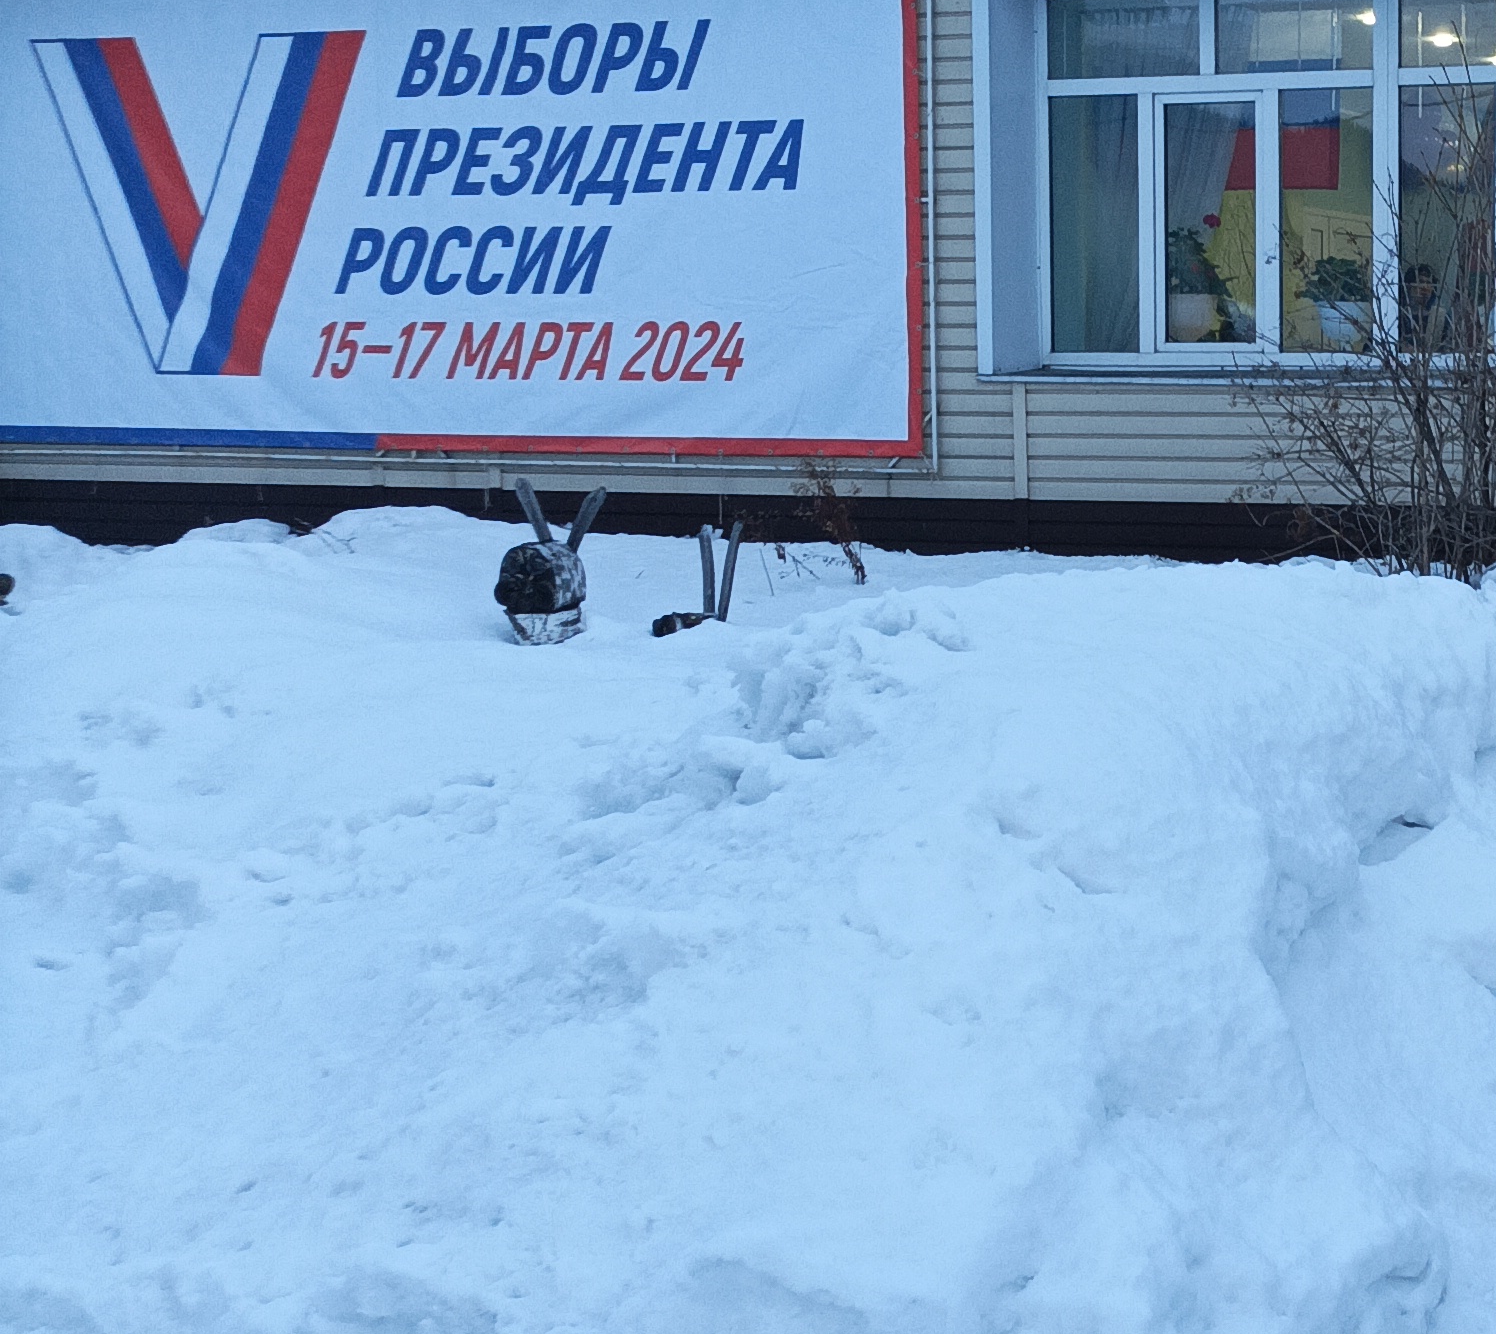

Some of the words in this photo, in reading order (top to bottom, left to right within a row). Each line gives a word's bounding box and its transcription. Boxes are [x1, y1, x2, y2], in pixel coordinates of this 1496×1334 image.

[396, 19, 711, 98] ВЫБОРЫ
[365, 119, 806, 205] ПРЕЗИДЕНТА
[334, 225, 611, 295] РОССИИ
[446, 321, 615, 382] МАРТА
[619, 320, 745, 383] 2024
